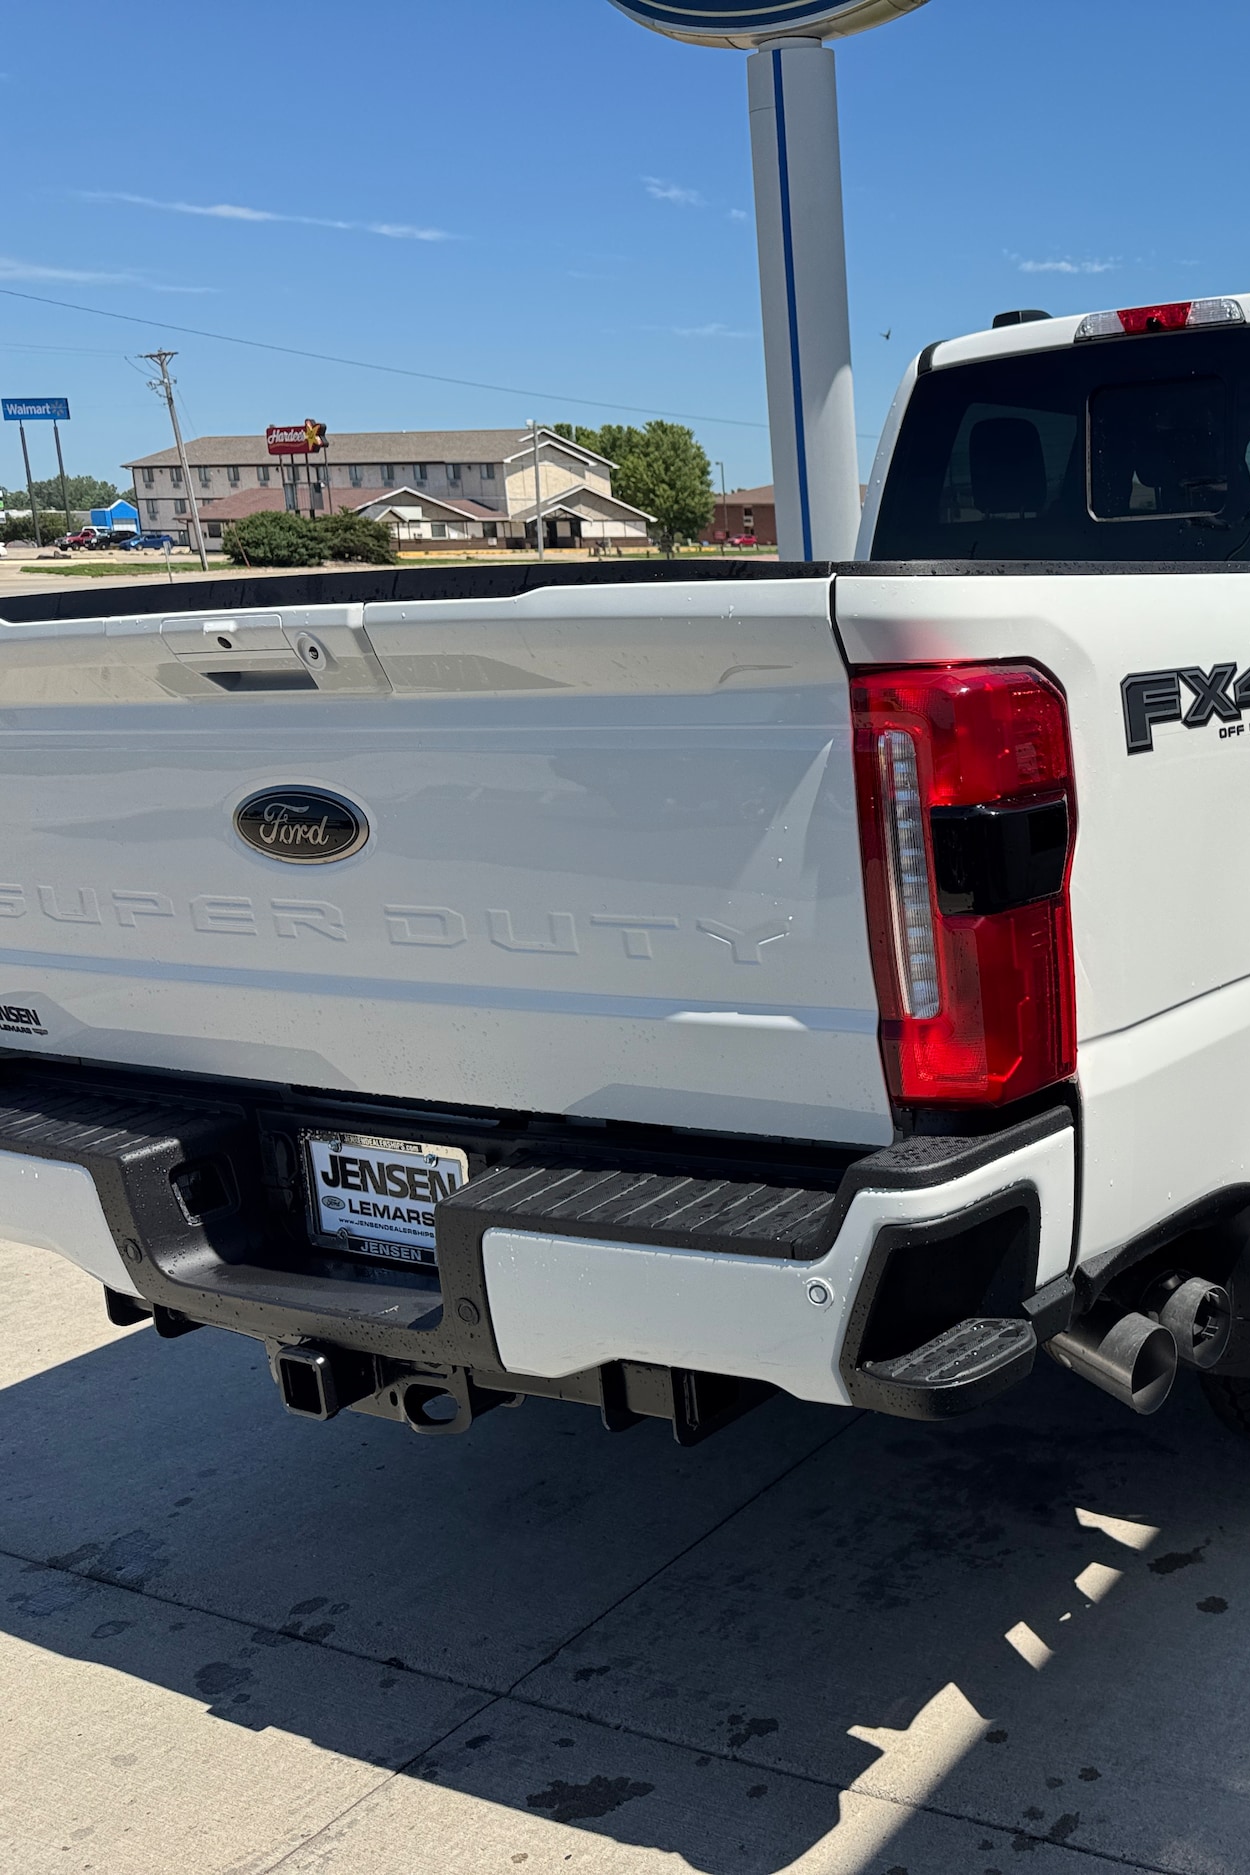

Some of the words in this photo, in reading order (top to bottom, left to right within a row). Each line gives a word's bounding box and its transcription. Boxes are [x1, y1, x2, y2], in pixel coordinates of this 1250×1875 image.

[6, 403, 51, 415] Walmart
[1219, 724, 1244, 739] OFF
[260, 802, 329, 846] Ford
[384, 902, 791, 965] DUTY
[321, 1154, 457, 1203] JENSEN
[348, 1199, 435, 1227] LEMARS
[361, 1241, 421, 1261] JENSEN
